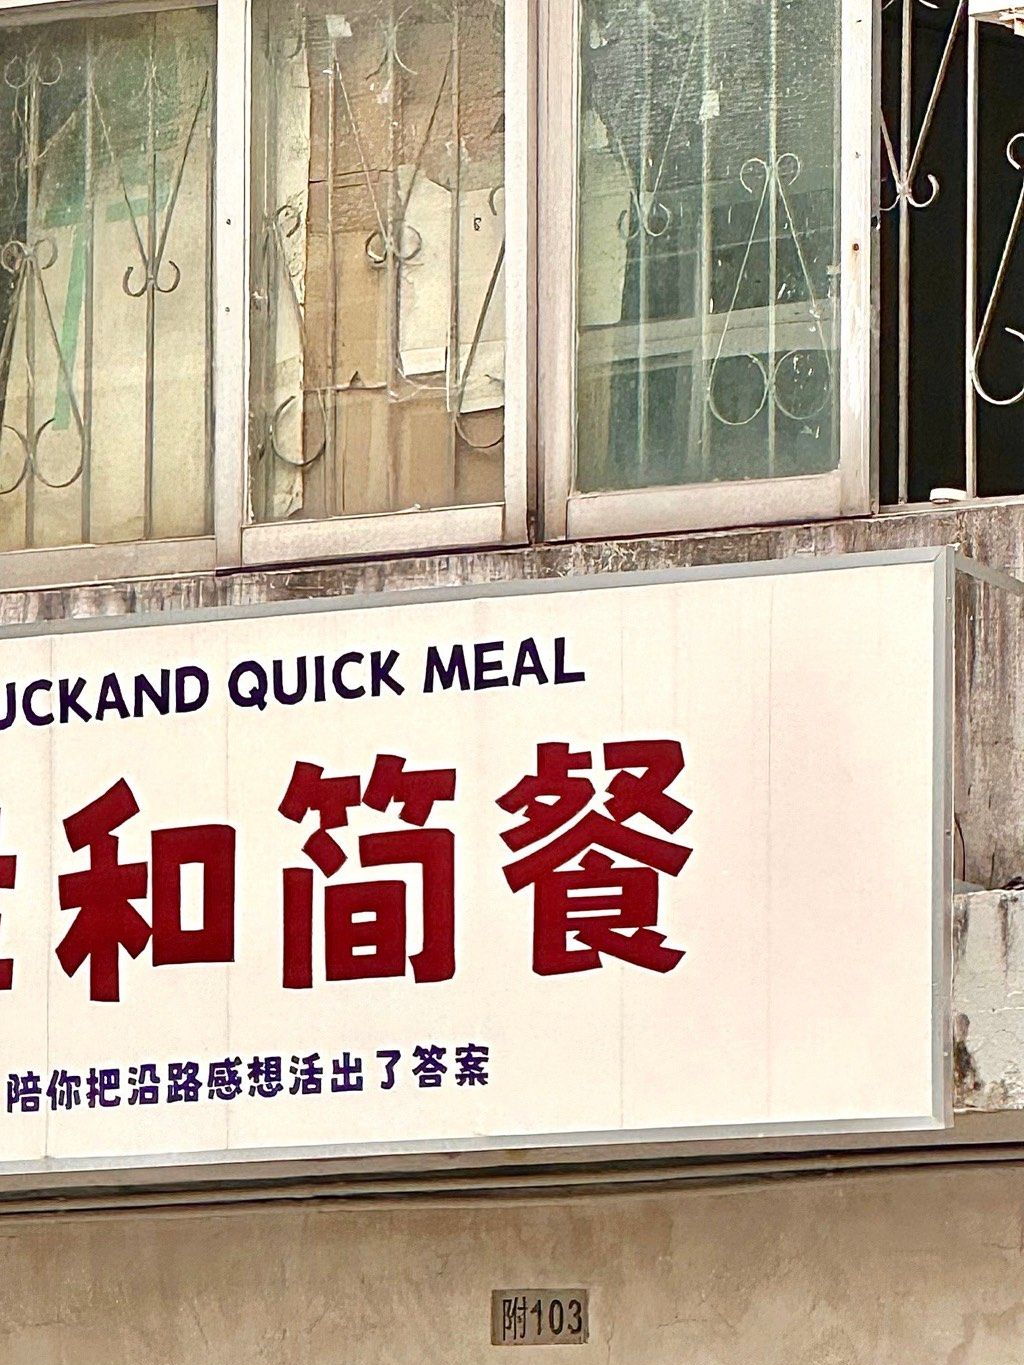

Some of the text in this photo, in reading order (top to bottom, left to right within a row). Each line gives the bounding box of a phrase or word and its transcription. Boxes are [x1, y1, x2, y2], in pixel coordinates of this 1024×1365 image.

[227, 649, 406, 712] QUICK
[422, 636, 586, 694] MEAL
[6, 1042, 491, 1114] 陪你把沿路感想活出了答案
[502, 1296, 584, 1341] 附103
